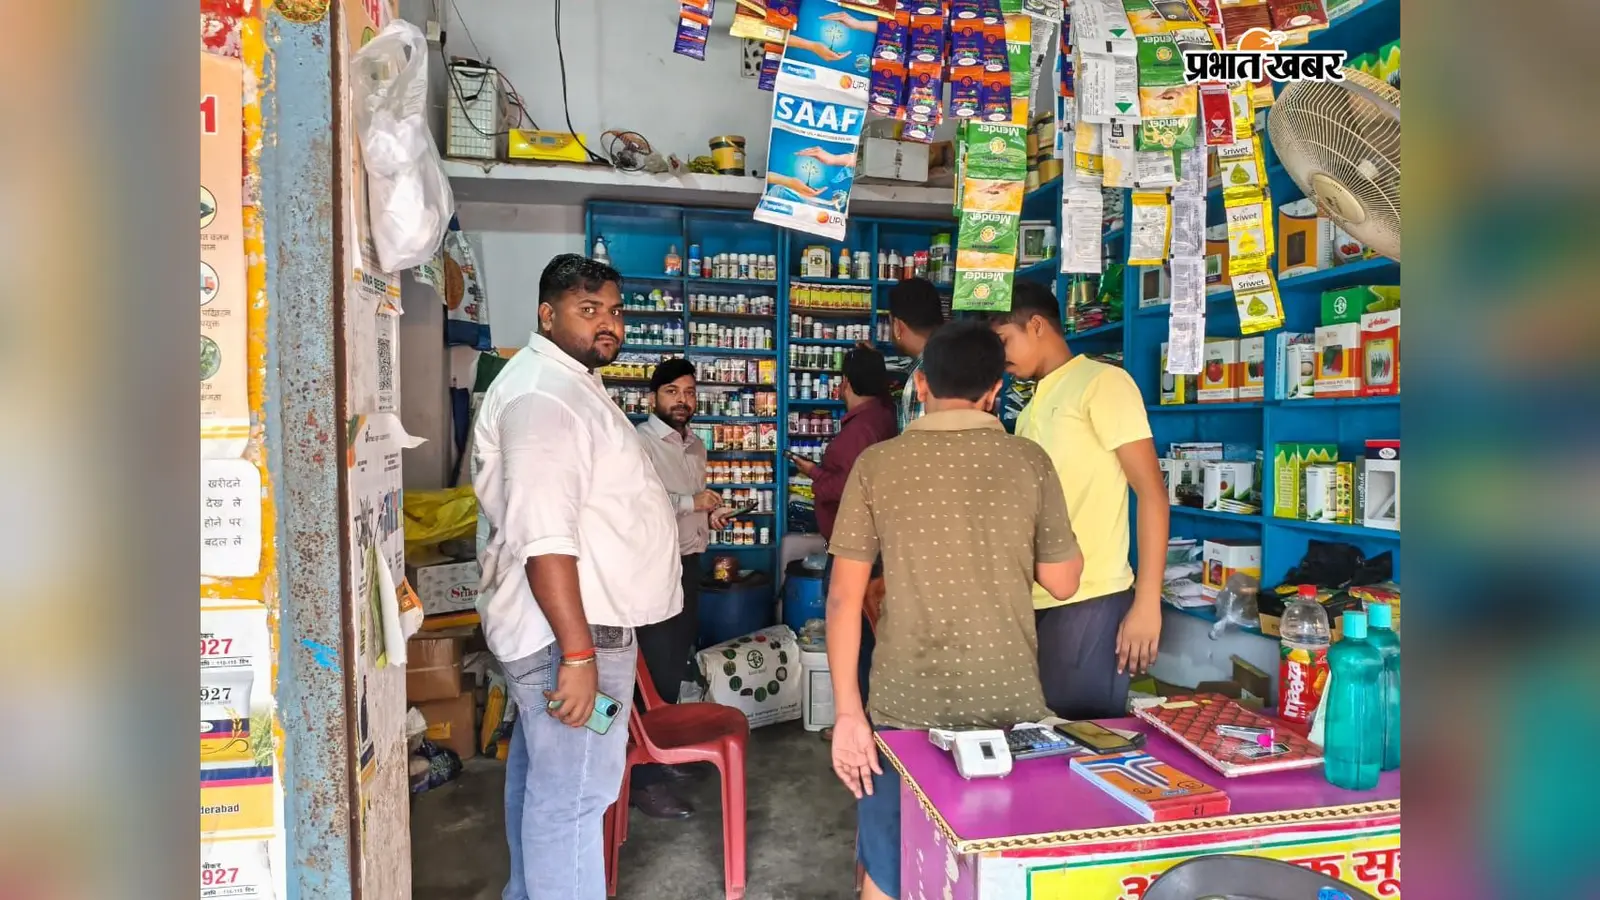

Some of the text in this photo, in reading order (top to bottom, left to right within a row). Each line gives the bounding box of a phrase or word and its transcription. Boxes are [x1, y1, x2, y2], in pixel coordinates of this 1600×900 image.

[1143, 36, 1175, 45] ender
[852, 80, 869, 92] UPL
[776, 96, 859, 132] SAAF
[977, 124, 1020, 137] Mender
[828, 215, 845, 226] UPL
[970, 213, 1012, 225] Mender
[1232, 212, 1257, 221] Sriwet
[963, 271, 1004, 282] Mender
[1239, 279, 1265, 289] Sriwet
[207, 477, 241, 488] खरीदने
[204, 516, 241, 528] होने पर
[451, 586, 478, 598] Srika
[1284, 661, 1305, 718] maaza
[200, 804, 239, 814] derabad
[202, 867, 239, 885] 927
[1353, 848, 1400, 896] सू
